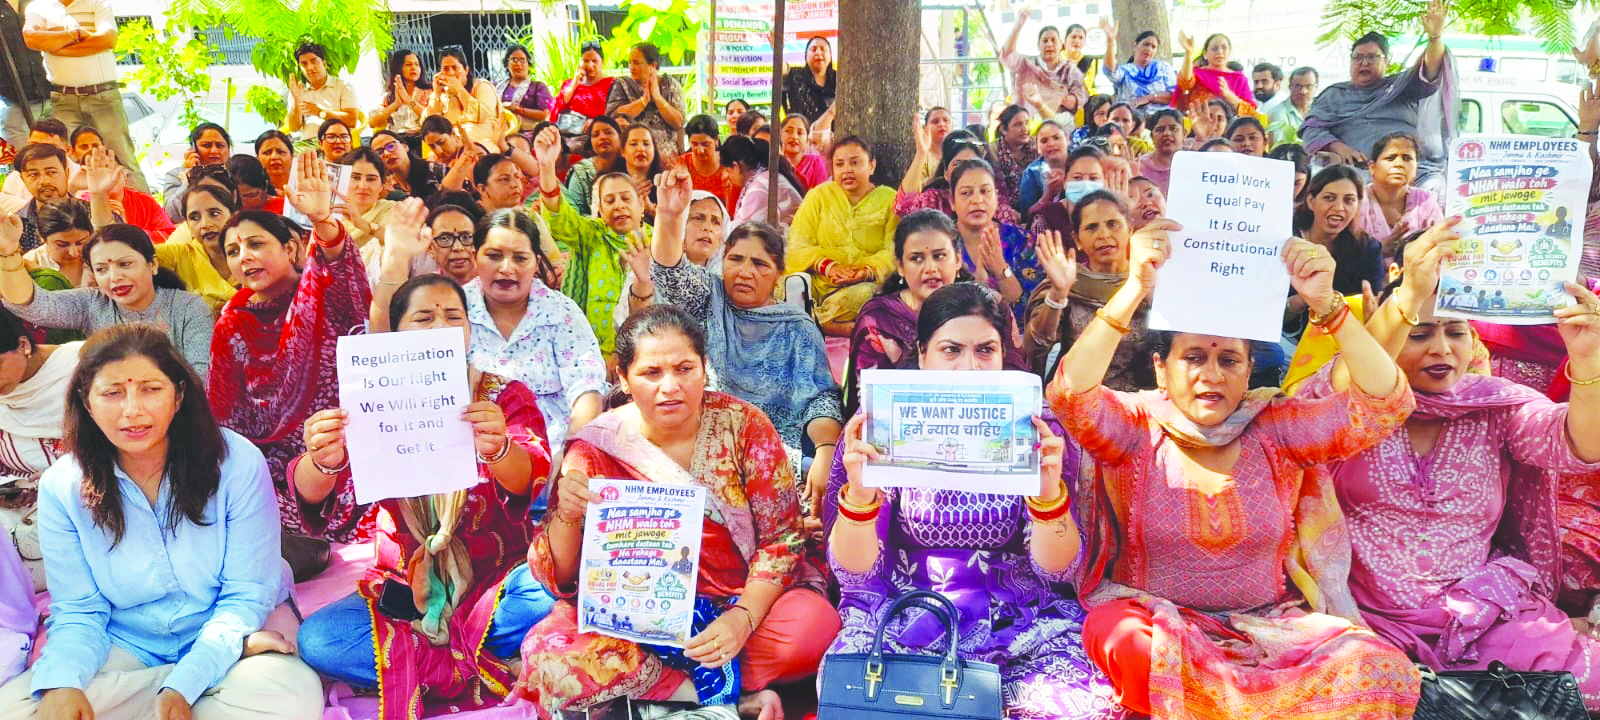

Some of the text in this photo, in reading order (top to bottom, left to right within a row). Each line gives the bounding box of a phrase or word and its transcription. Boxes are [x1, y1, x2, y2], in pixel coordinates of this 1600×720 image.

[818, 0, 838, 8] EMPL
[720, 66, 757, 74] RETIREMENT
[722, 77, 768, 86] Social Security
[722, 90, 768, 100] Loyalty Benefit
[1489, 140, 1578, 152] NHM EMPLOYEES
[1469, 166, 1550, 180] Naa samjho ge
[1202, 172, 1271, 189] Equal Work
[1468, 178, 1548, 194] NHM walo toh
[1206, 194, 1265, 212] Equal Pay
[1480, 190, 1536, 203] mit jawoge
[1486, 214, 1498, 224] Na
[1209, 219, 1261, 233] It Is Our
[1184, 238, 1278, 257] Constitutional
[1210, 262, 1245, 276] Right
[351, 348, 454, 368] Regularization
[363, 378, 374, 389] Is
[378, 376, 404, 387] Our
[360, 395, 456, 413] We Will Fight
[899, 406, 1006, 420] WE WANT JUSTICE
[379, 422, 399, 433] for
[418, 417, 444, 428] and
[903, 420, 1001, 437] हमें न्याय चाहिए
[396, 442, 422, 454] Get
[625, 485, 696, 497] NHM EMPLOYEES
[606, 506, 675, 519] Naa samjho ge
[605, 519, 674, 532] NHM walo toh
[615, 530, 666, 540] mit jawoge
